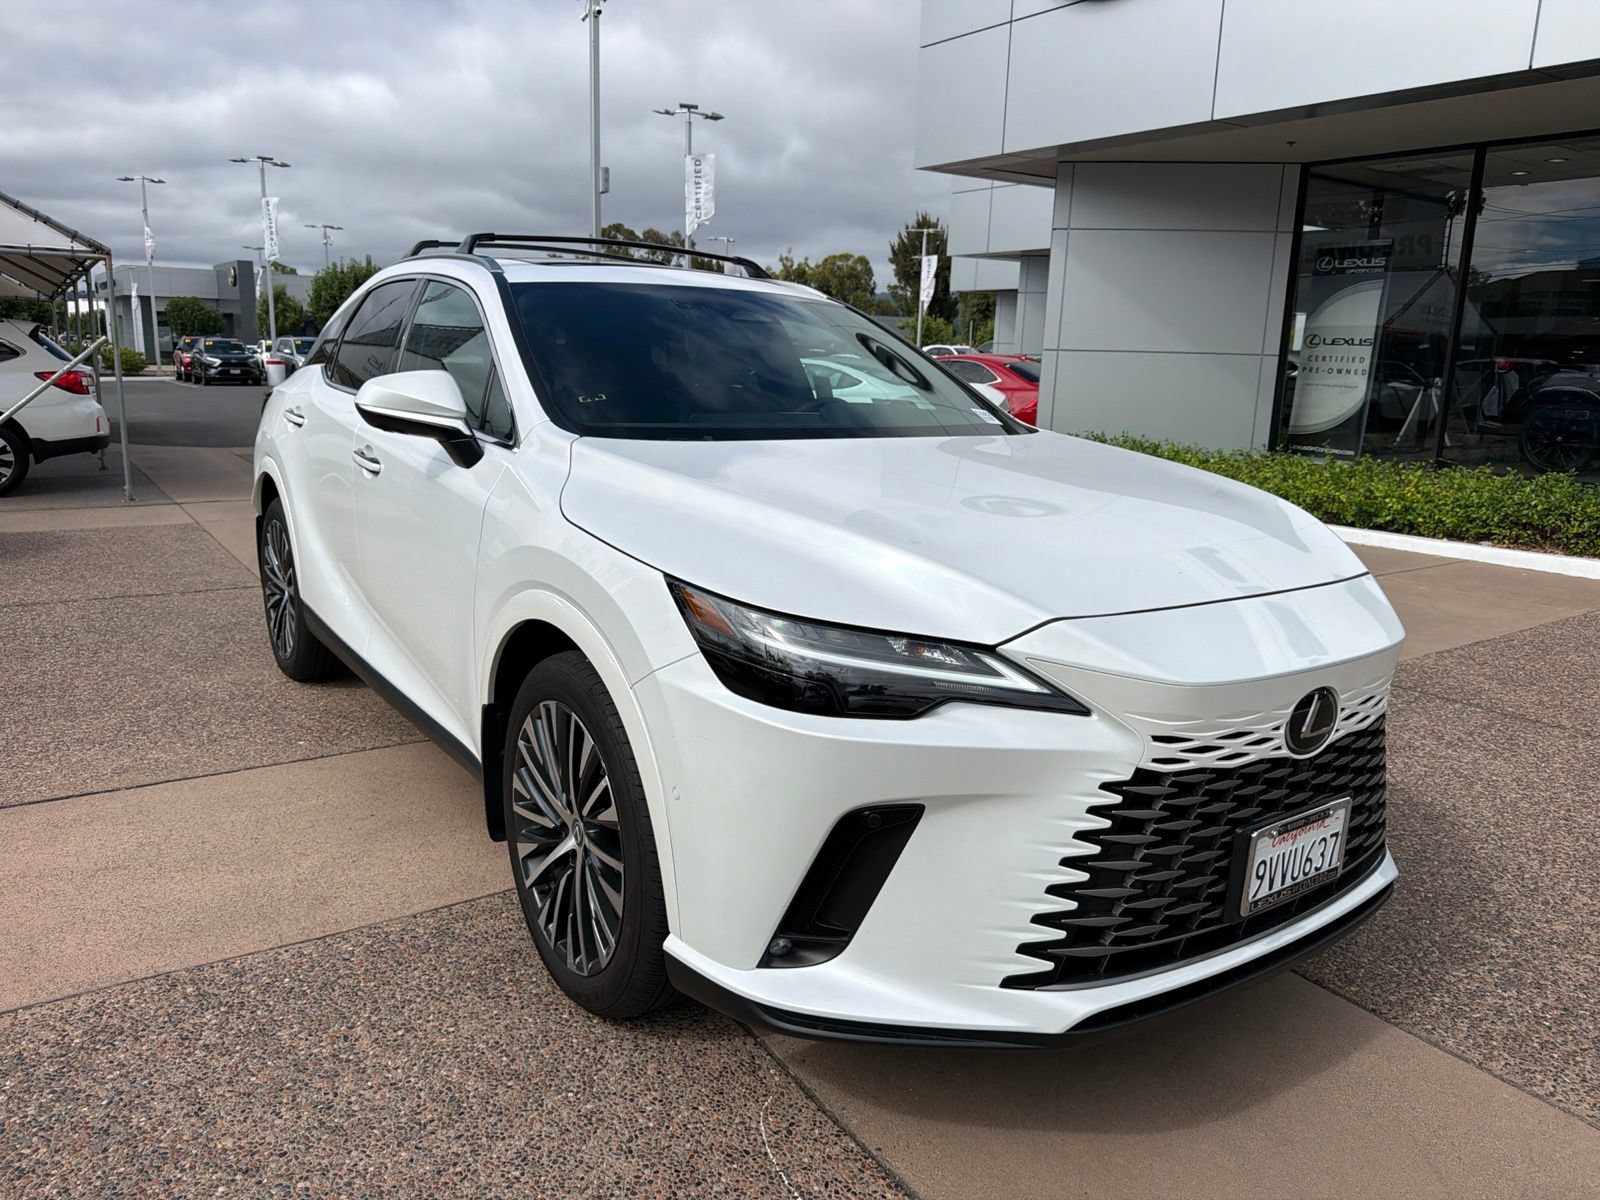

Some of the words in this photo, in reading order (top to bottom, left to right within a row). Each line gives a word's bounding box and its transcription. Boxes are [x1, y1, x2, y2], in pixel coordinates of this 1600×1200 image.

[694, 159, 703, 220] CERTIFIED
[1335, 257, 1386, 268] LEXUS
[1323, 337, 1374, 346] LEXUS
[1308, 355, 1365, 363] CERTIFIED
[1302, 366, 1367, 376] PRE-OWNED
[1272, 820, 1330, 848] California
[1251, 831, 1340, 899] 9VVU637
[1251, 887, 1292, 911] LEXUS
